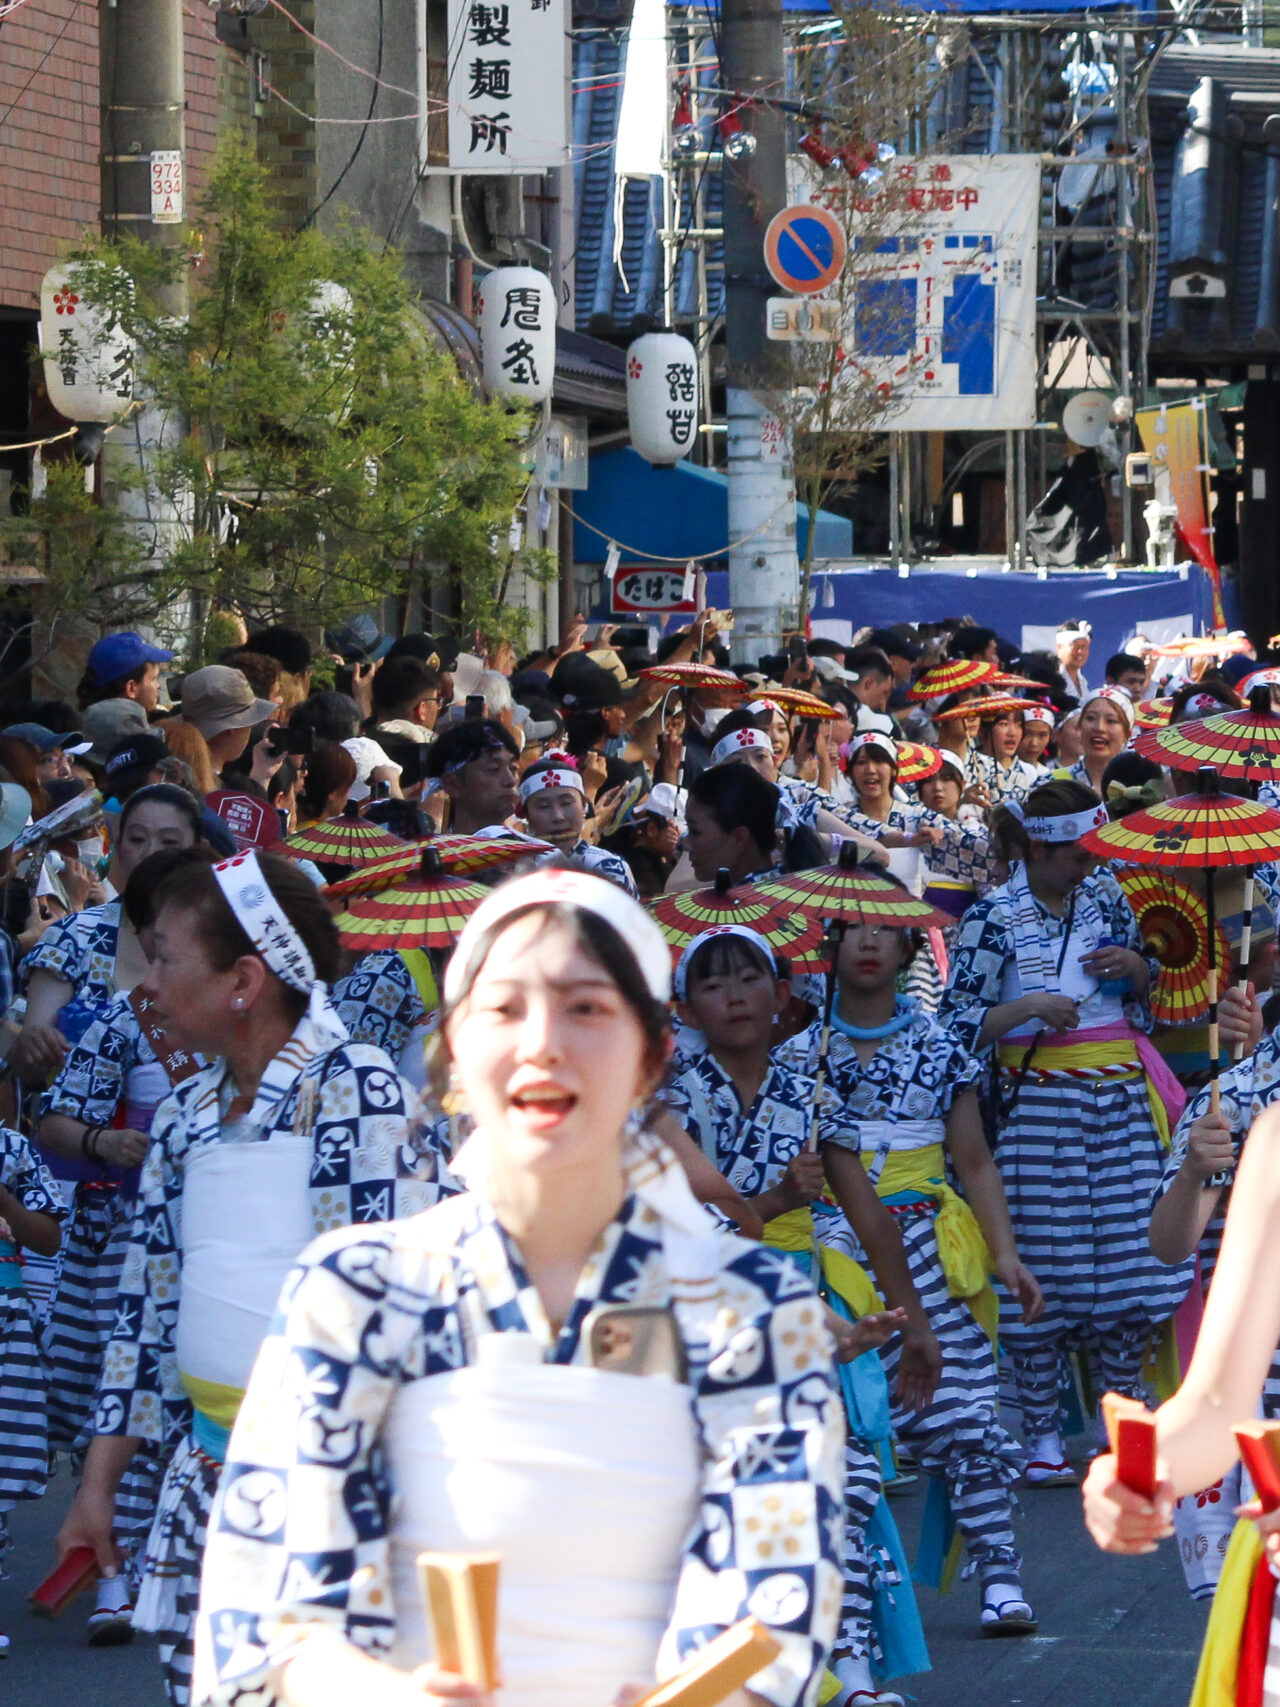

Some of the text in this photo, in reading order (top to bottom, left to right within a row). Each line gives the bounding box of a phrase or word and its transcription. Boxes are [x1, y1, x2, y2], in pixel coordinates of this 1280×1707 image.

[468, 3, 512, 155] 製麺所
[152, 163, 181, 178] 972
[151, 180, 181, 195] 334
[164, 196, 173, 211] A
